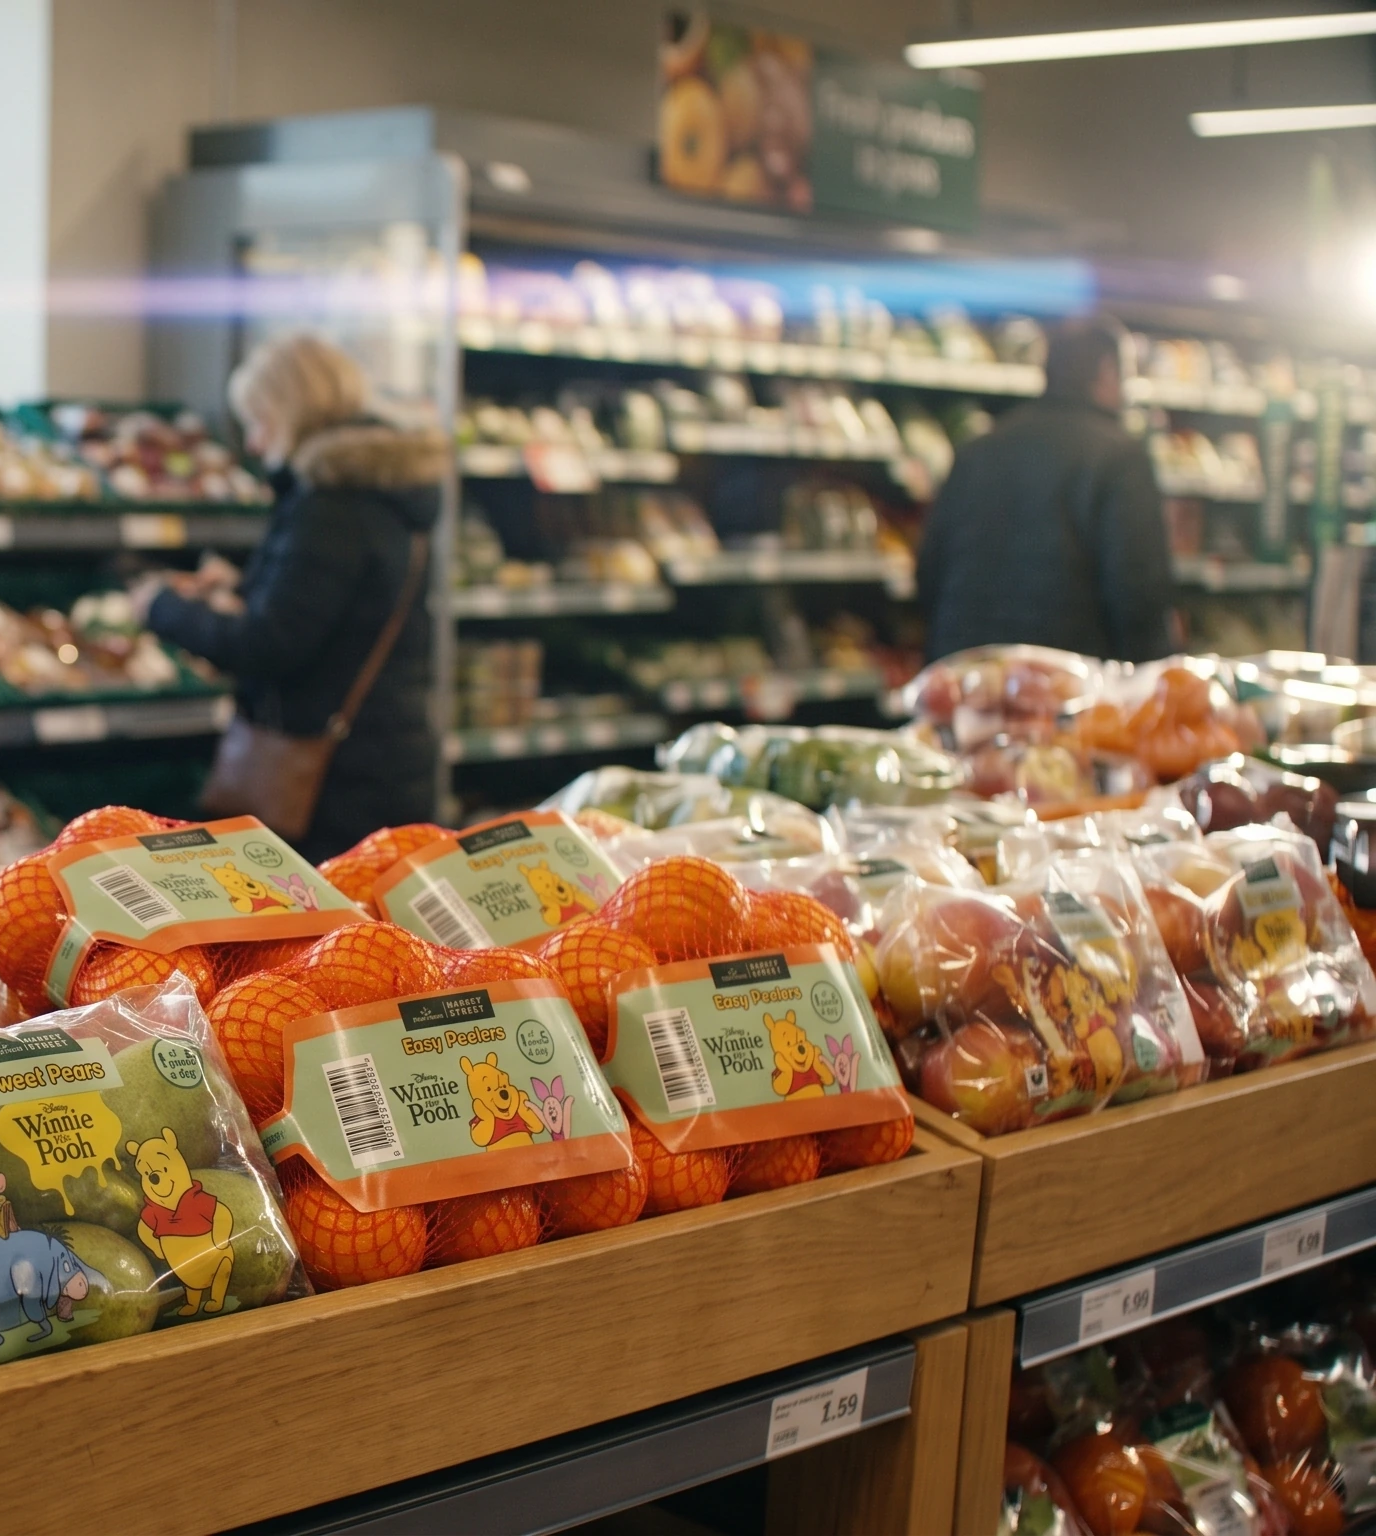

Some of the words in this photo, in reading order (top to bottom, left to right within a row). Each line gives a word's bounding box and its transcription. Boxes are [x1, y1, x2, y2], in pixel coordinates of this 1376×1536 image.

[171, 888, 219, 902] Pooh
[713, 994, 749, 1010] Easy
[749, 986, 802, 1005] Peelers
[401, 1037, 443, 1056] Easy
[445, 1026, 506, 1049] Peelers
[702, 1031, 764, 1055] Winnie
[47, 1060, 106, 1089] Pears
[718, 1050, 764, 1076] Pooh
[389, 1076, 459, 1104] Winnie
[12, 1108, 94, 1139] Winnie
[407, 1098, 461, 1126] Pooh
[34, 1132, 97, 1166] Pooh
[821, 1392, 859, 1425] 1.59
